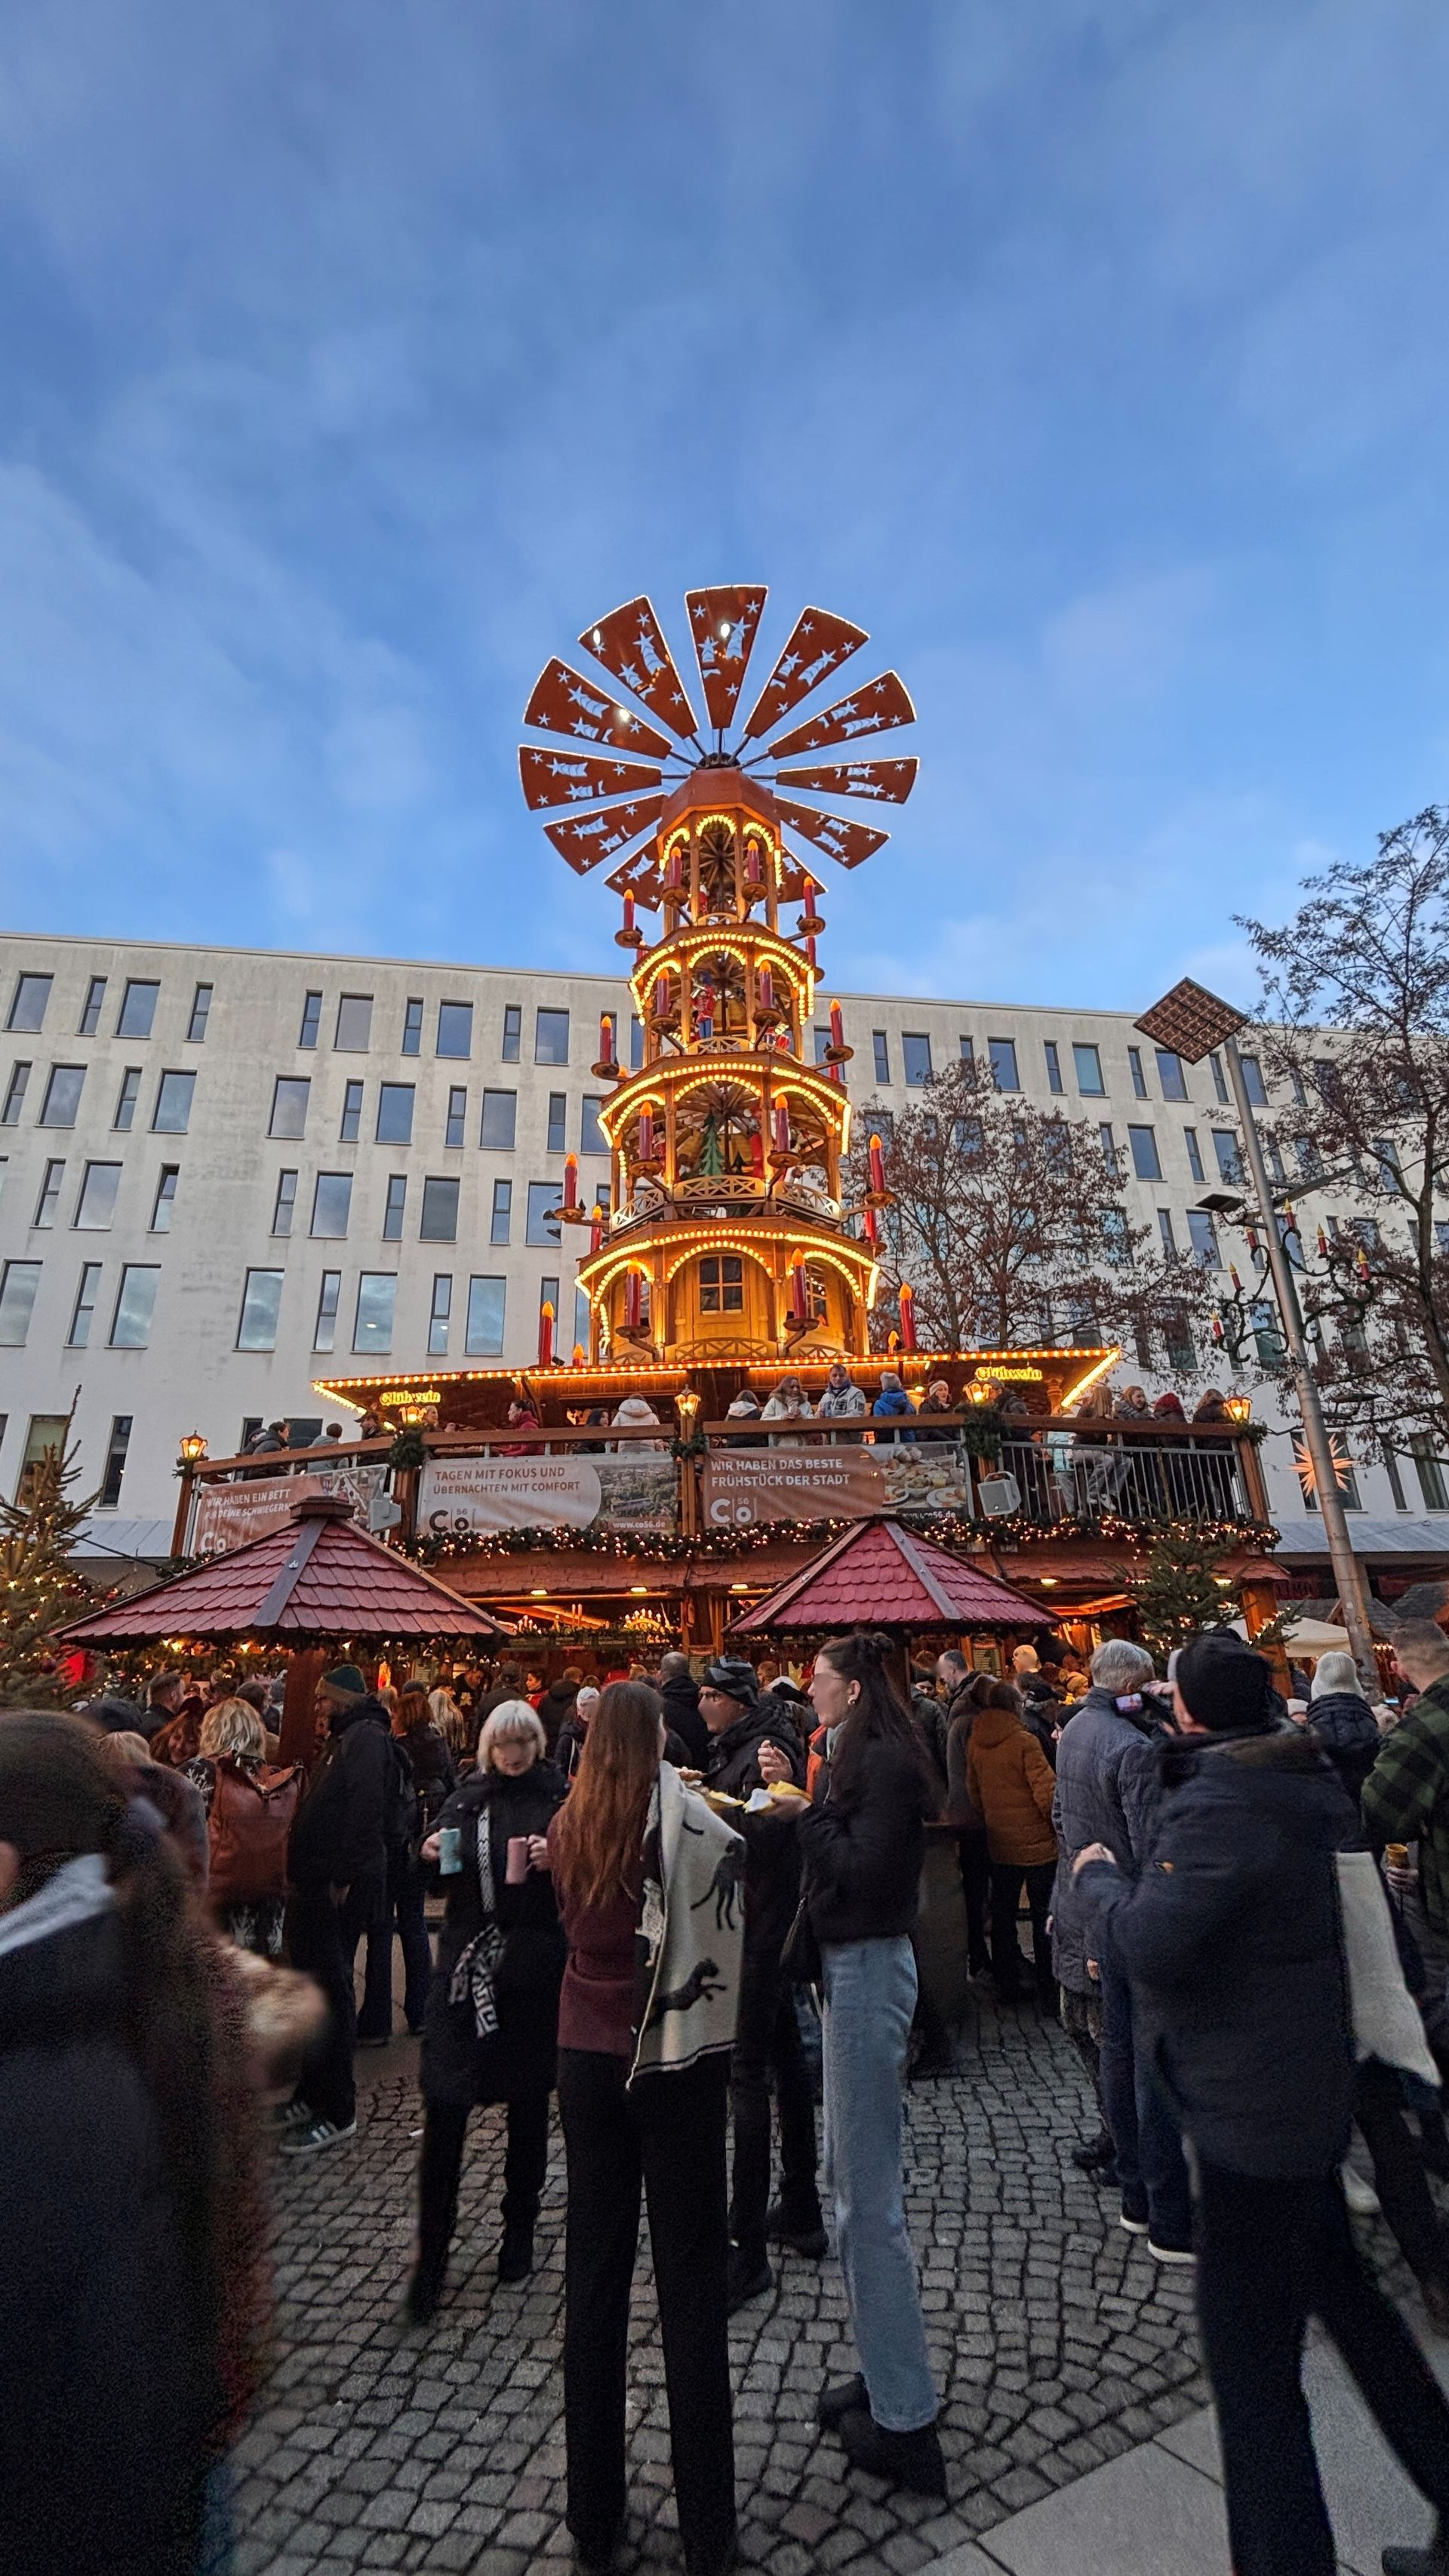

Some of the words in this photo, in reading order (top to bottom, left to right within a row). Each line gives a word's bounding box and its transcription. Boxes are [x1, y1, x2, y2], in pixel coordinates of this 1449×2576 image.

[711, 1460, 733, 1471] WIR
[736, 1460, 776, 1471] HABEN
[779, 1459, 802, 1470] DAS
[804, 1458, 843, 1469] BESTE
[435, 1471, 472, 1481] TAGEN
[475, 1470, 496, 1479] MIT
[499, 1469, 537, 1479] FOKUS
[540, 1467, 565, 1477] UND
[711, 1474, 783, 1487] FRÜHSTÜCK
[786, 1476, 810, 1485] DER
[813, 1474, 851, 1485] STADT
[434, 1483, 508, 1494] ÜBERNACHTEN
[511, 1482, 529, 1492] MIT
[531, 1481, 580, 1491] COMFORT
[207, 1496, 224, 1507] WIR
[224, 1494, 250, 1506] HABEN
[253, 1492, 266, 1503] EIN
[269, 1488, 291, 1500] BETT
[218, 1508, 242, 1519] DEINE
[242, 1502, 294, 1516] SCHWIEGERM
[613, 1519, 666, 1528] www.co56.de
